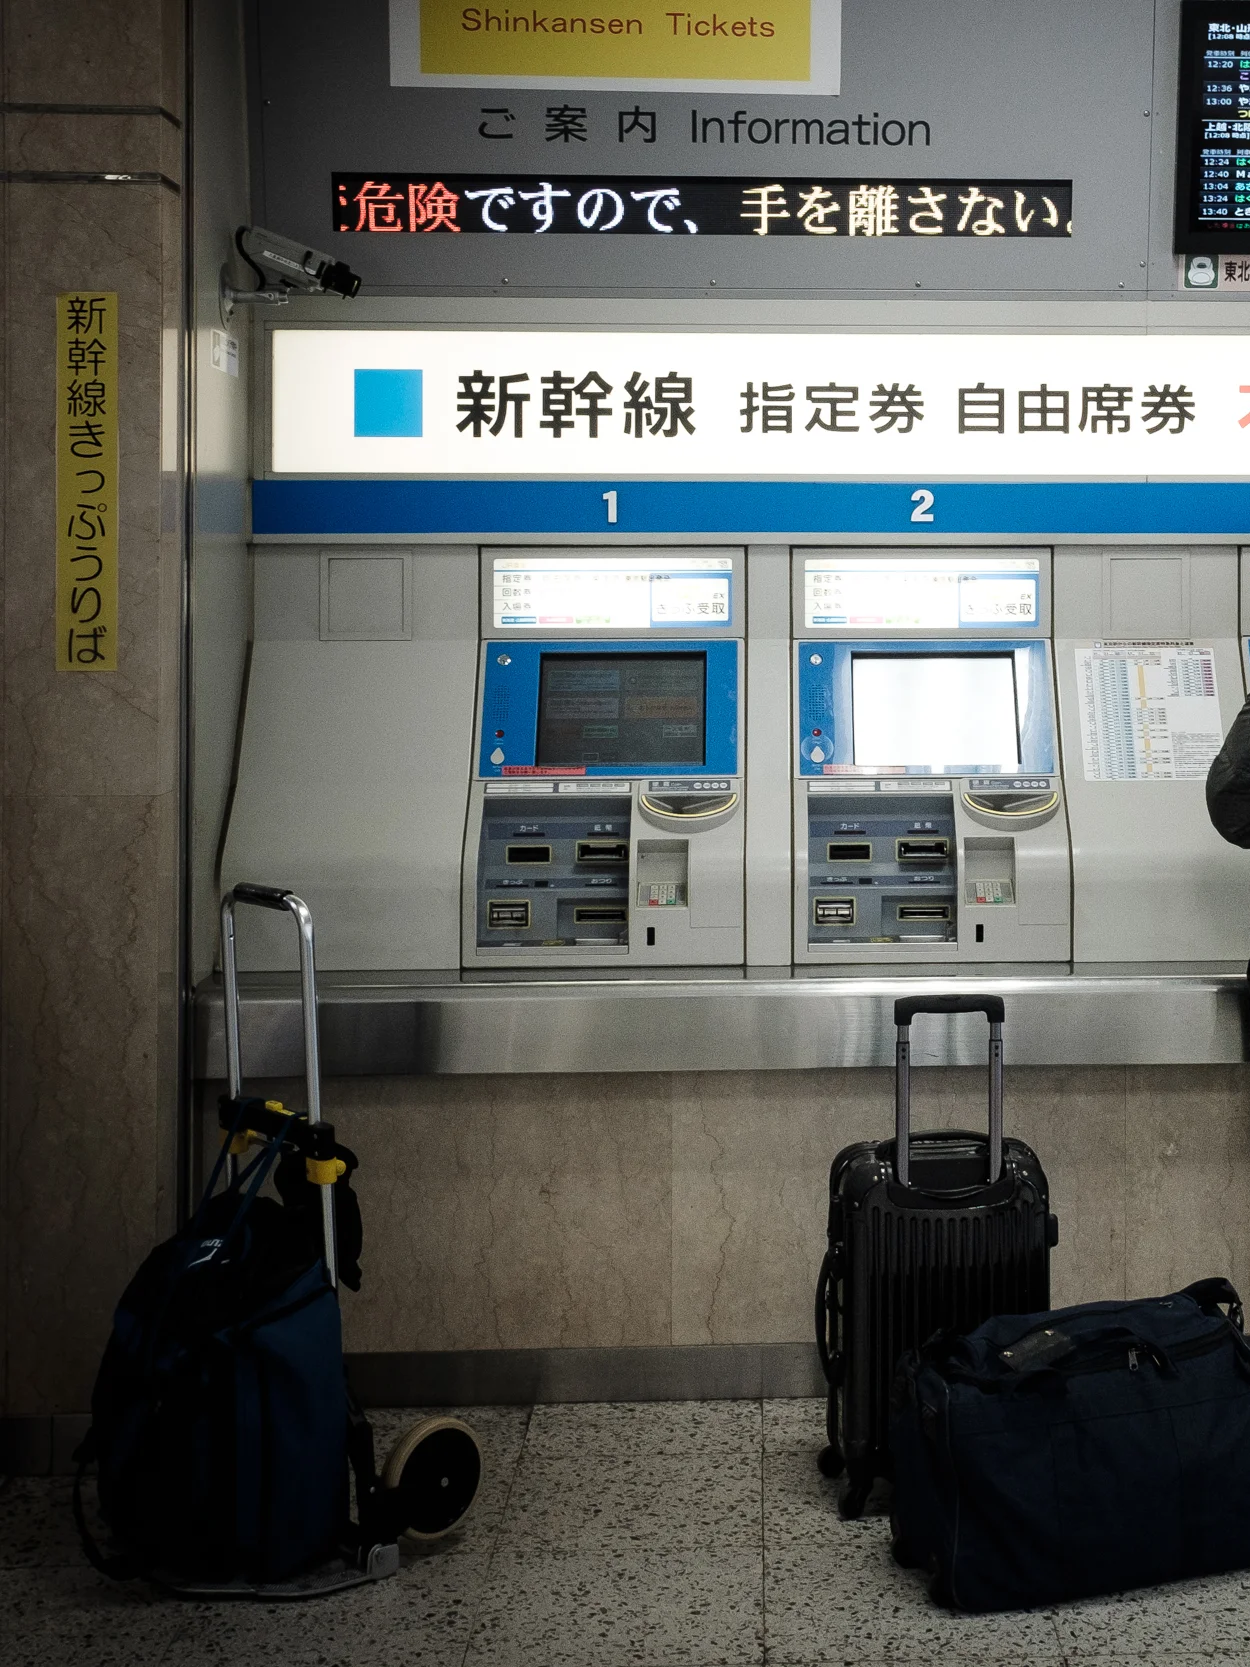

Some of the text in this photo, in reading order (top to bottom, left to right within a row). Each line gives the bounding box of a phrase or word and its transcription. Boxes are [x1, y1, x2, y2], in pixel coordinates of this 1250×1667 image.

[461, 9, 776, 38] Shinkansen Tickets
[477, 105, 931, 146] ご案内 Information
[455, 370, 697, 438] 新幹線
[740, 382, 925, 434] 指定券
[957, 382, 1196, 436] 自由席券
[67, 296, 107, 664] 新幹線きっぷうりば
[601, 490, 619, 523] 1
[909, 490, 935, 522] 2
